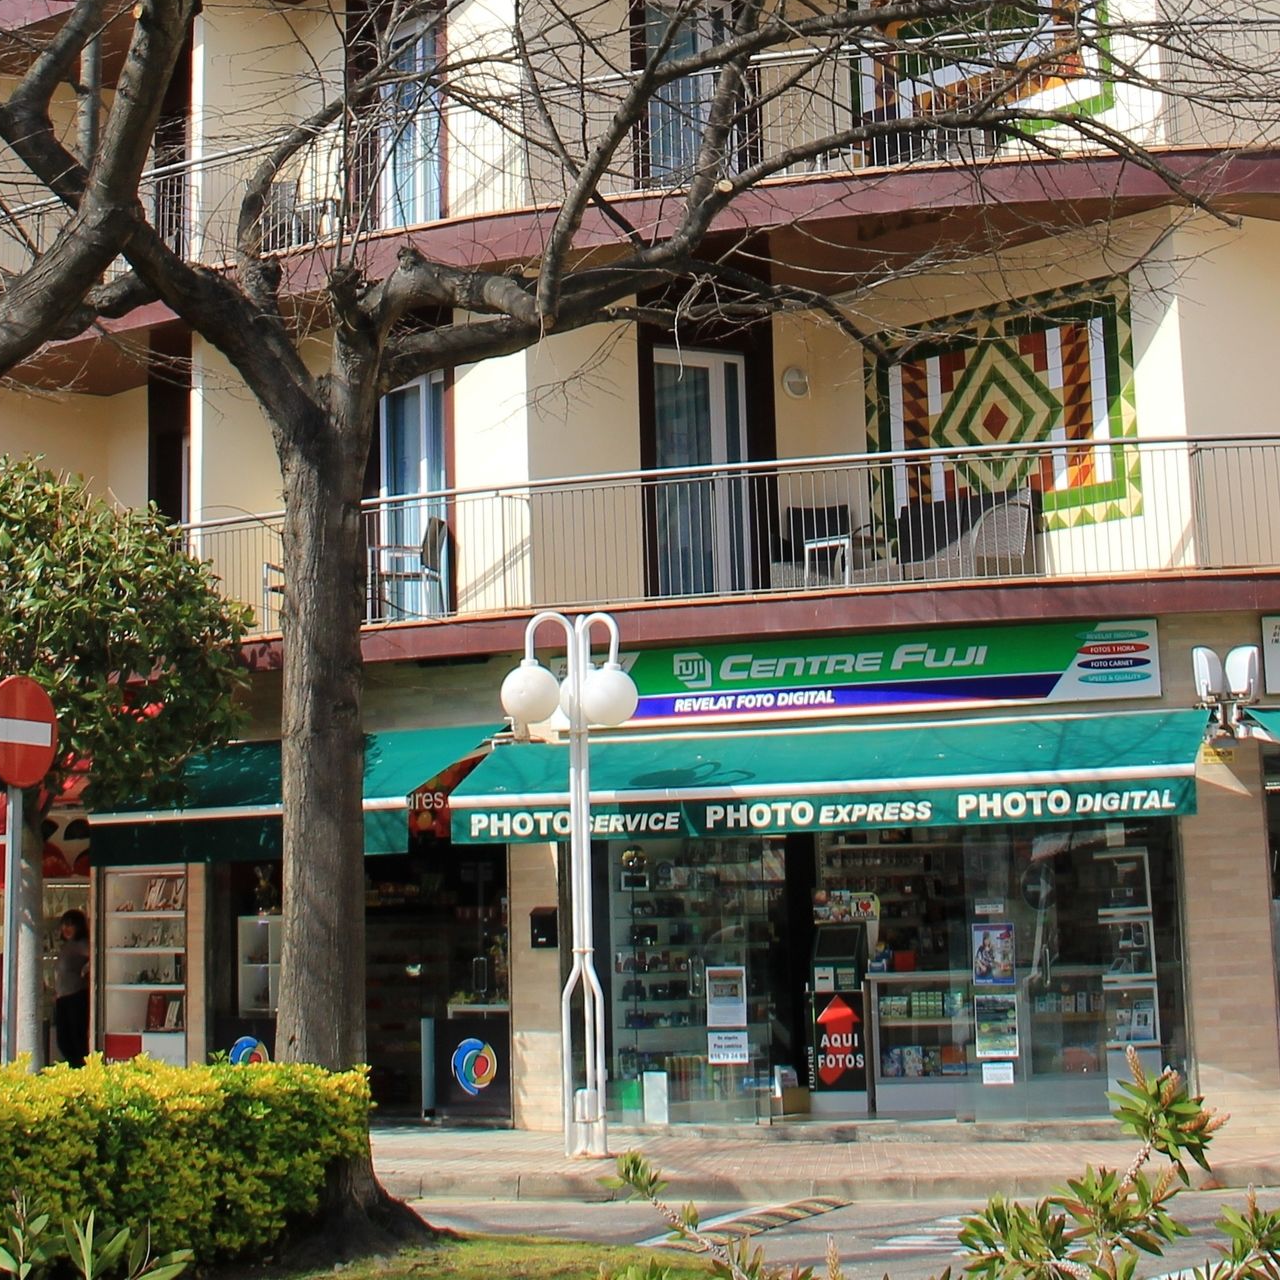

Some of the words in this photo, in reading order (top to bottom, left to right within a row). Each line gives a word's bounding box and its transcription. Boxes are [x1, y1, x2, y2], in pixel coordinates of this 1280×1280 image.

[719, 651, 883, 681] CENTRE
[675, 696, 735, 712] REVELAT
[736, 693, 775, 709] FOTO
[777, 690, 835, 706] DIGITAL
[706, 801, 814, 829] PHOTO
[819, 801, 932, 825] EXPRESS
[958, 789, 1071, 819] PHOTO
[1076, 789, 1176, 813] DIGITAL
[471, 811, 571, 837] PHOTO
[820, 1033, 858, 1047] AQUI
[818, 1054, 864, 1069] FOTOS
